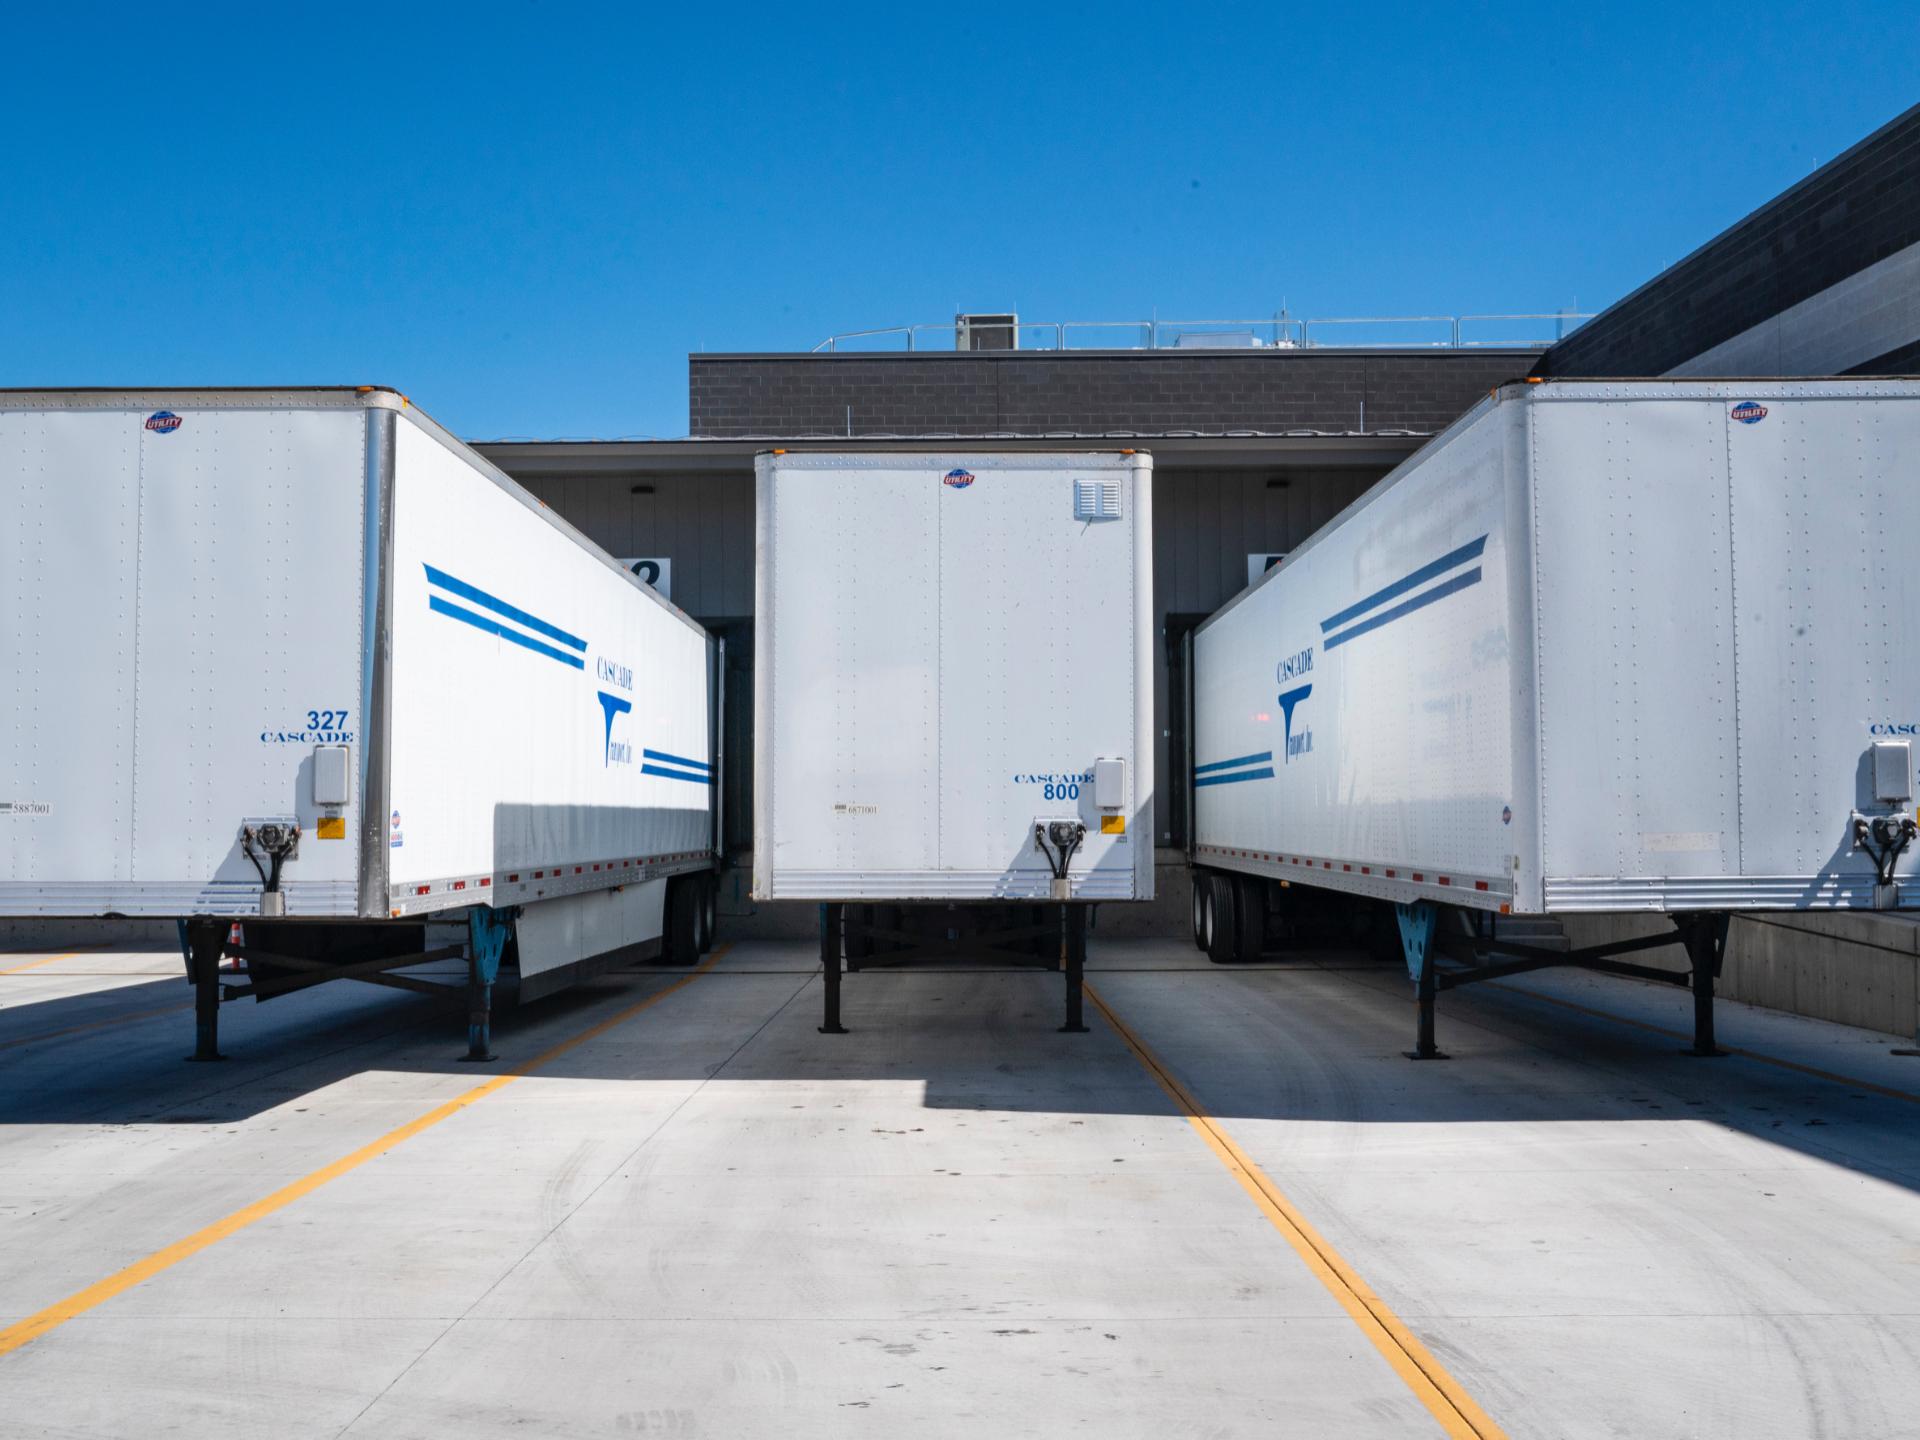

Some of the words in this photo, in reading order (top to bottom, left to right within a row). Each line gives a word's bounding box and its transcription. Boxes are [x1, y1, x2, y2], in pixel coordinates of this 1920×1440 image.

[1732, 407, 1767, 419] UTILITY
[146, 417, 181, 429] UTILITY
[944, 475, 974, 484] UTILITY
[1277, 648, 1313, 684] CASCADE
[597, 656, 632, 690] CASCADE
[306, 710, 349, 730] 327
[260, 731, 354, 742] CASCADE
[1014, 773, 1095, 783] CASCADE
[1043, 783, 1079, 800] 800
